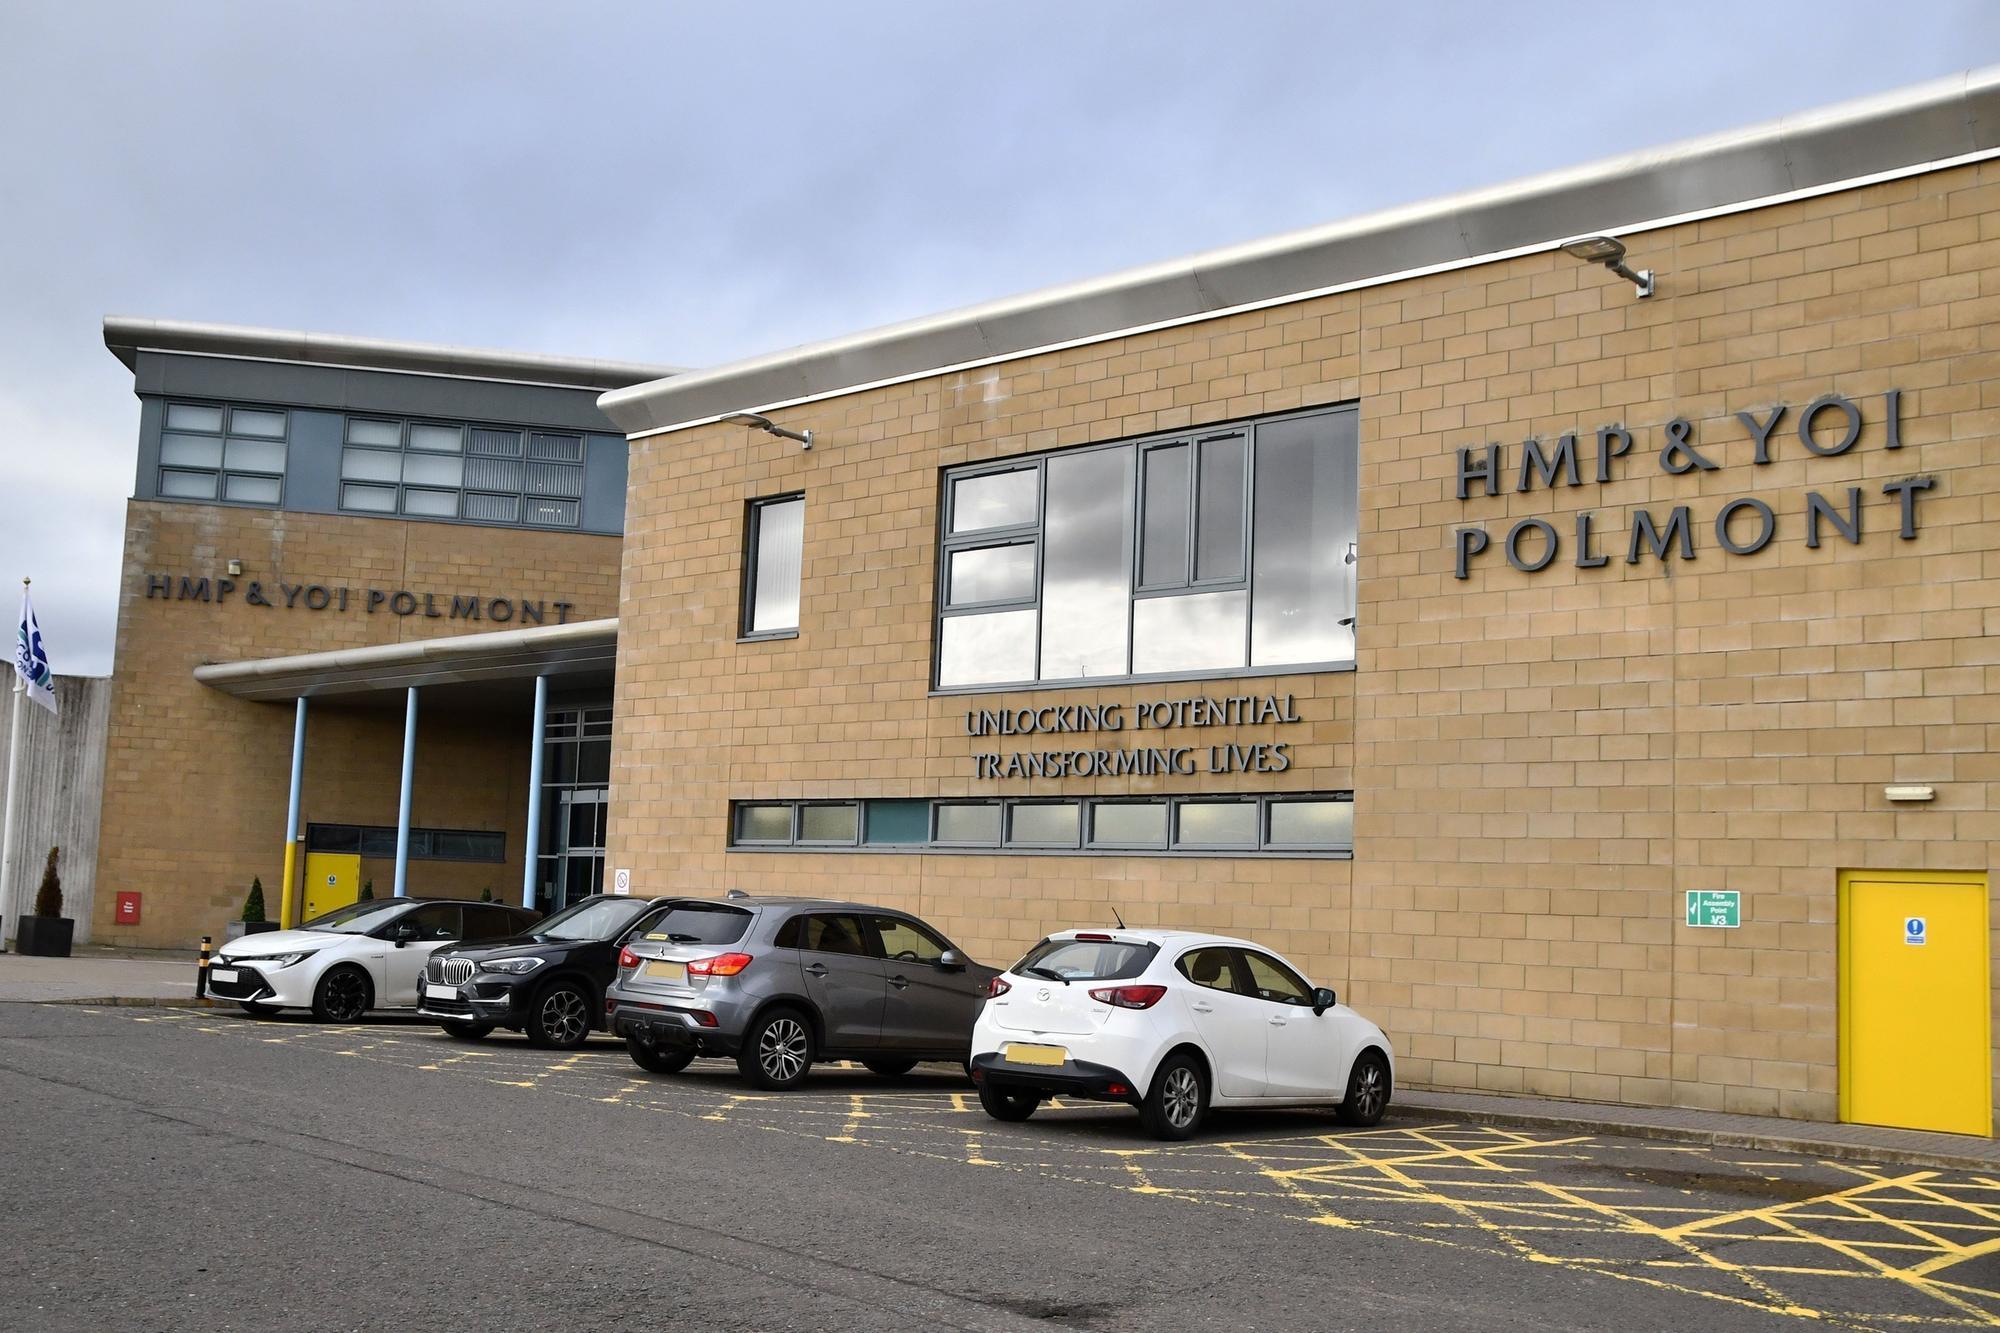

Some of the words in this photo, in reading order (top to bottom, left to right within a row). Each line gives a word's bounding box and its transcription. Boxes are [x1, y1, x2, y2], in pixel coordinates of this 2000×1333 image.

[1456, 427, 1632, 500] HMP
[1659, 417, 1720, 475] &
[1735, 389, 1903, 465] YOI
[1455, 477, 1935, 580] POLMONT
[146, 574, 235, 604] HMP
[246, 581, 273, 607] &
[281, 583, 348, 612] YOI
[367, 589, 573, 625] POLMONT
[965, 703, 1123, 737] UNLOCKING
[1135, 694, 1301, 730] POTENTIAL
[972, 746, 1195, 779] TRANSFORMING
[1208, 742, 1290, 774] LIVES
[1702, 900, 1735, 908] Assembly
[1712, 892, 1726, 900] Fire
